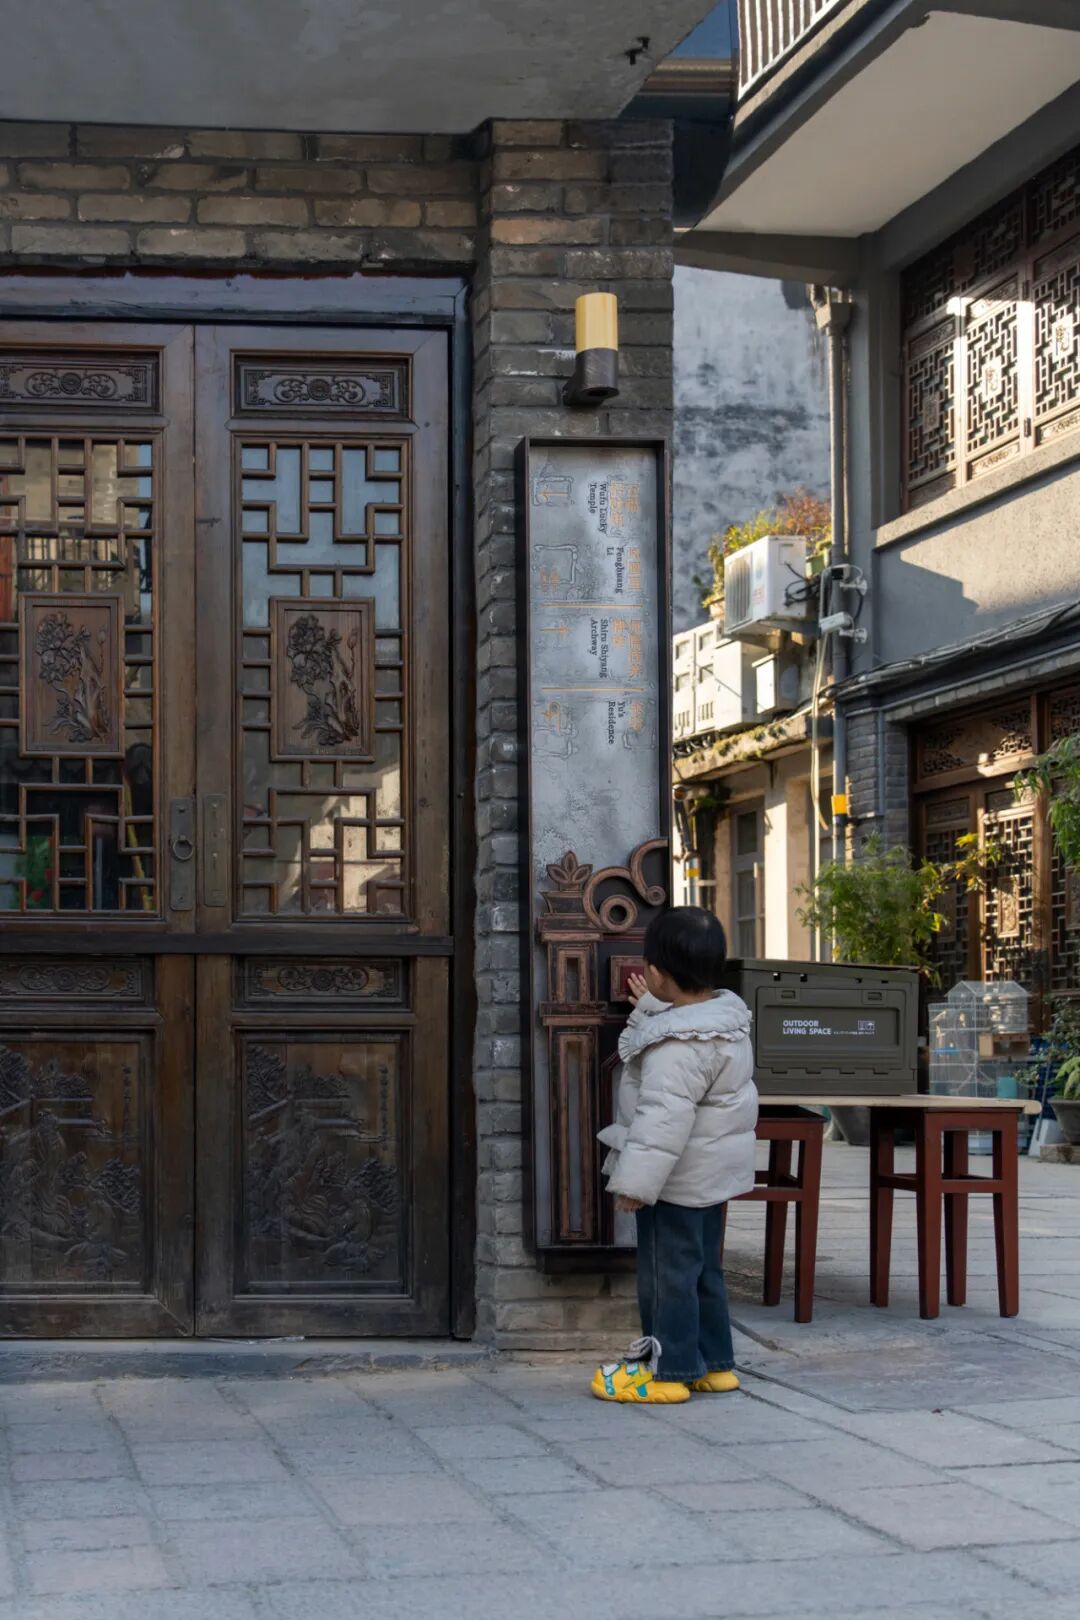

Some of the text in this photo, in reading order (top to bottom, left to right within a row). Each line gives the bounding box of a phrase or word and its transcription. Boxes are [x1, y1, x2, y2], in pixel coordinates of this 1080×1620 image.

[588, 483, 597, 514] Temple
[598, 483, 607, 534] Wufu Lucky
[607, 547, 614, 556] Li
[615, 547, 624, 594] Fenghuang
[589, 619, 598, 656] Archway
[599, 619, 608, 679] Shiru Shiyang
[608, 701, 616, 744] Residence
[618, 701, 626, 718] Yu's
